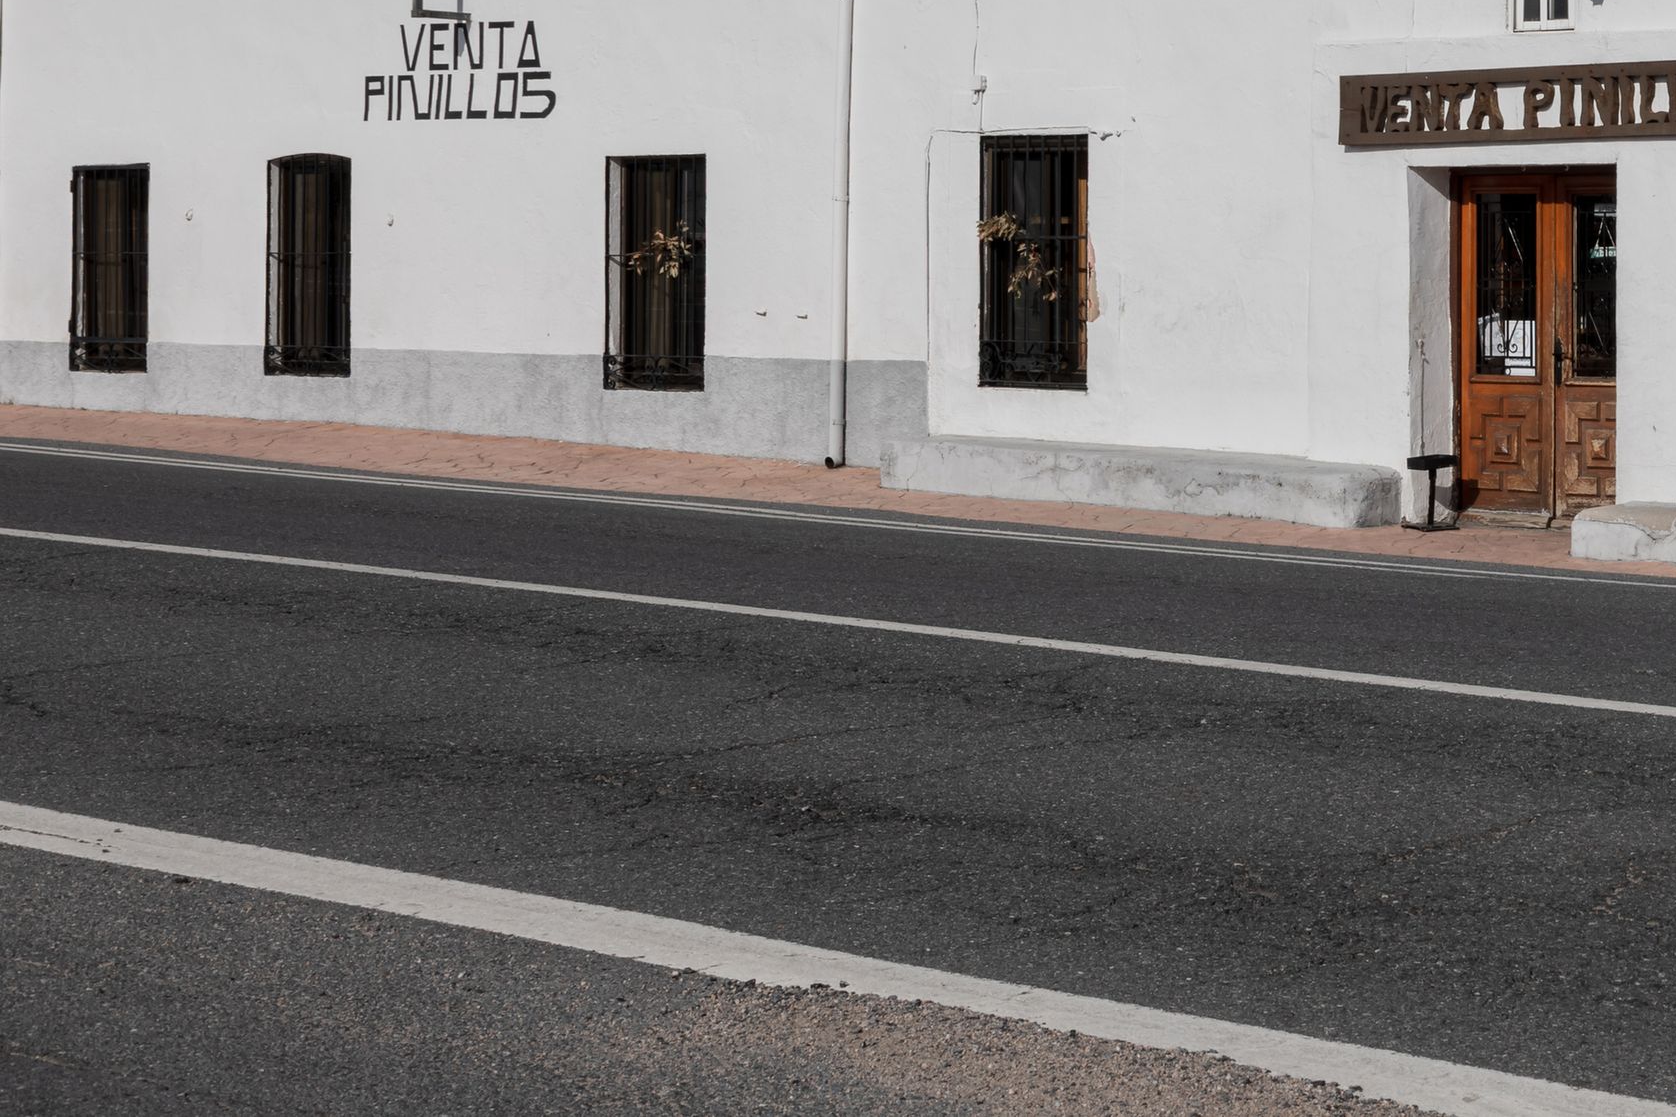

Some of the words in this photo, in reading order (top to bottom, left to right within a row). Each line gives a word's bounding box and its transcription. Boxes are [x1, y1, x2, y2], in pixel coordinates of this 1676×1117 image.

[400, 20, 541, 71] VENTA
[363, 71, 556, 121] PINILLOS
[1360, 83, 1504, 132] VENTA
